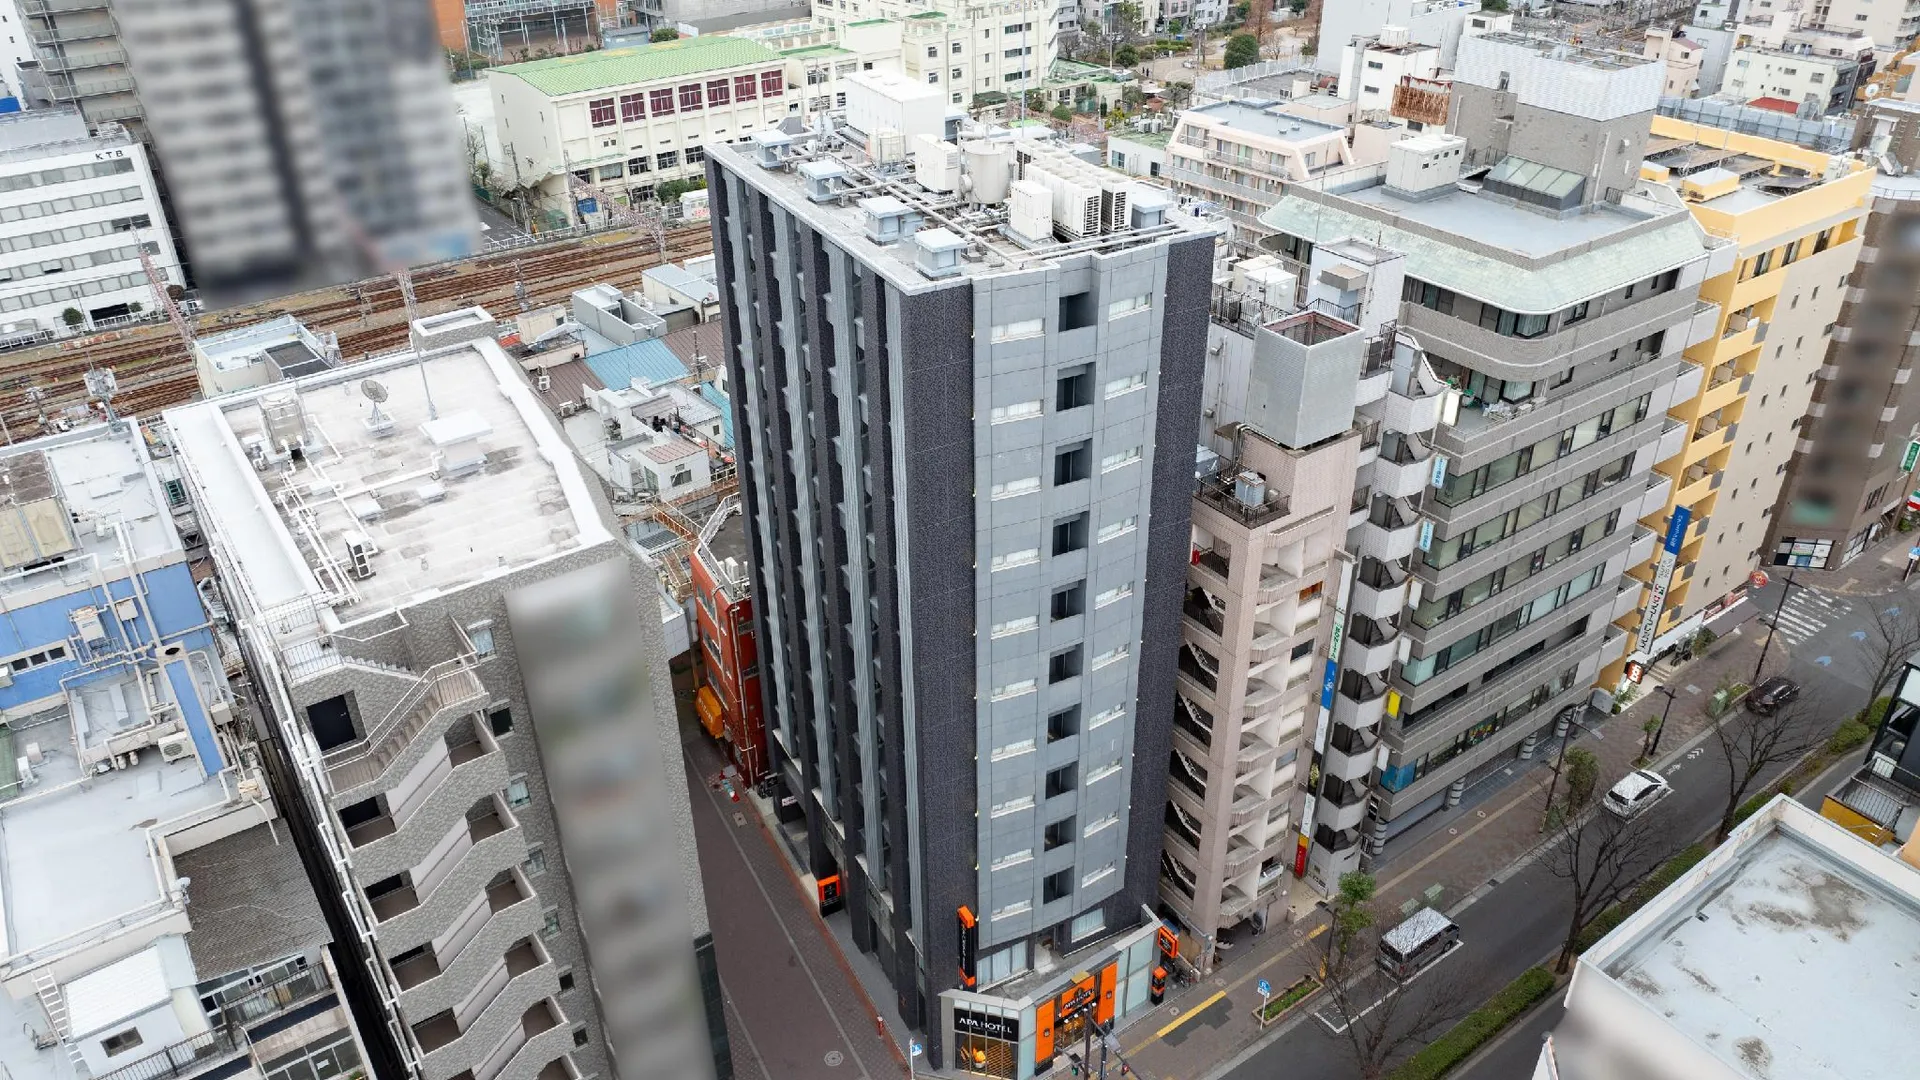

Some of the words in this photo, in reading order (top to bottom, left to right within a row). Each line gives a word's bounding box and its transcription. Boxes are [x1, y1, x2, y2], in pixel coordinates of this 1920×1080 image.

[95, 150, 124, 160] KTB
[959, 1017, 979, 1027] APA
[980, 1021, 1013, 1034] HOTEL
